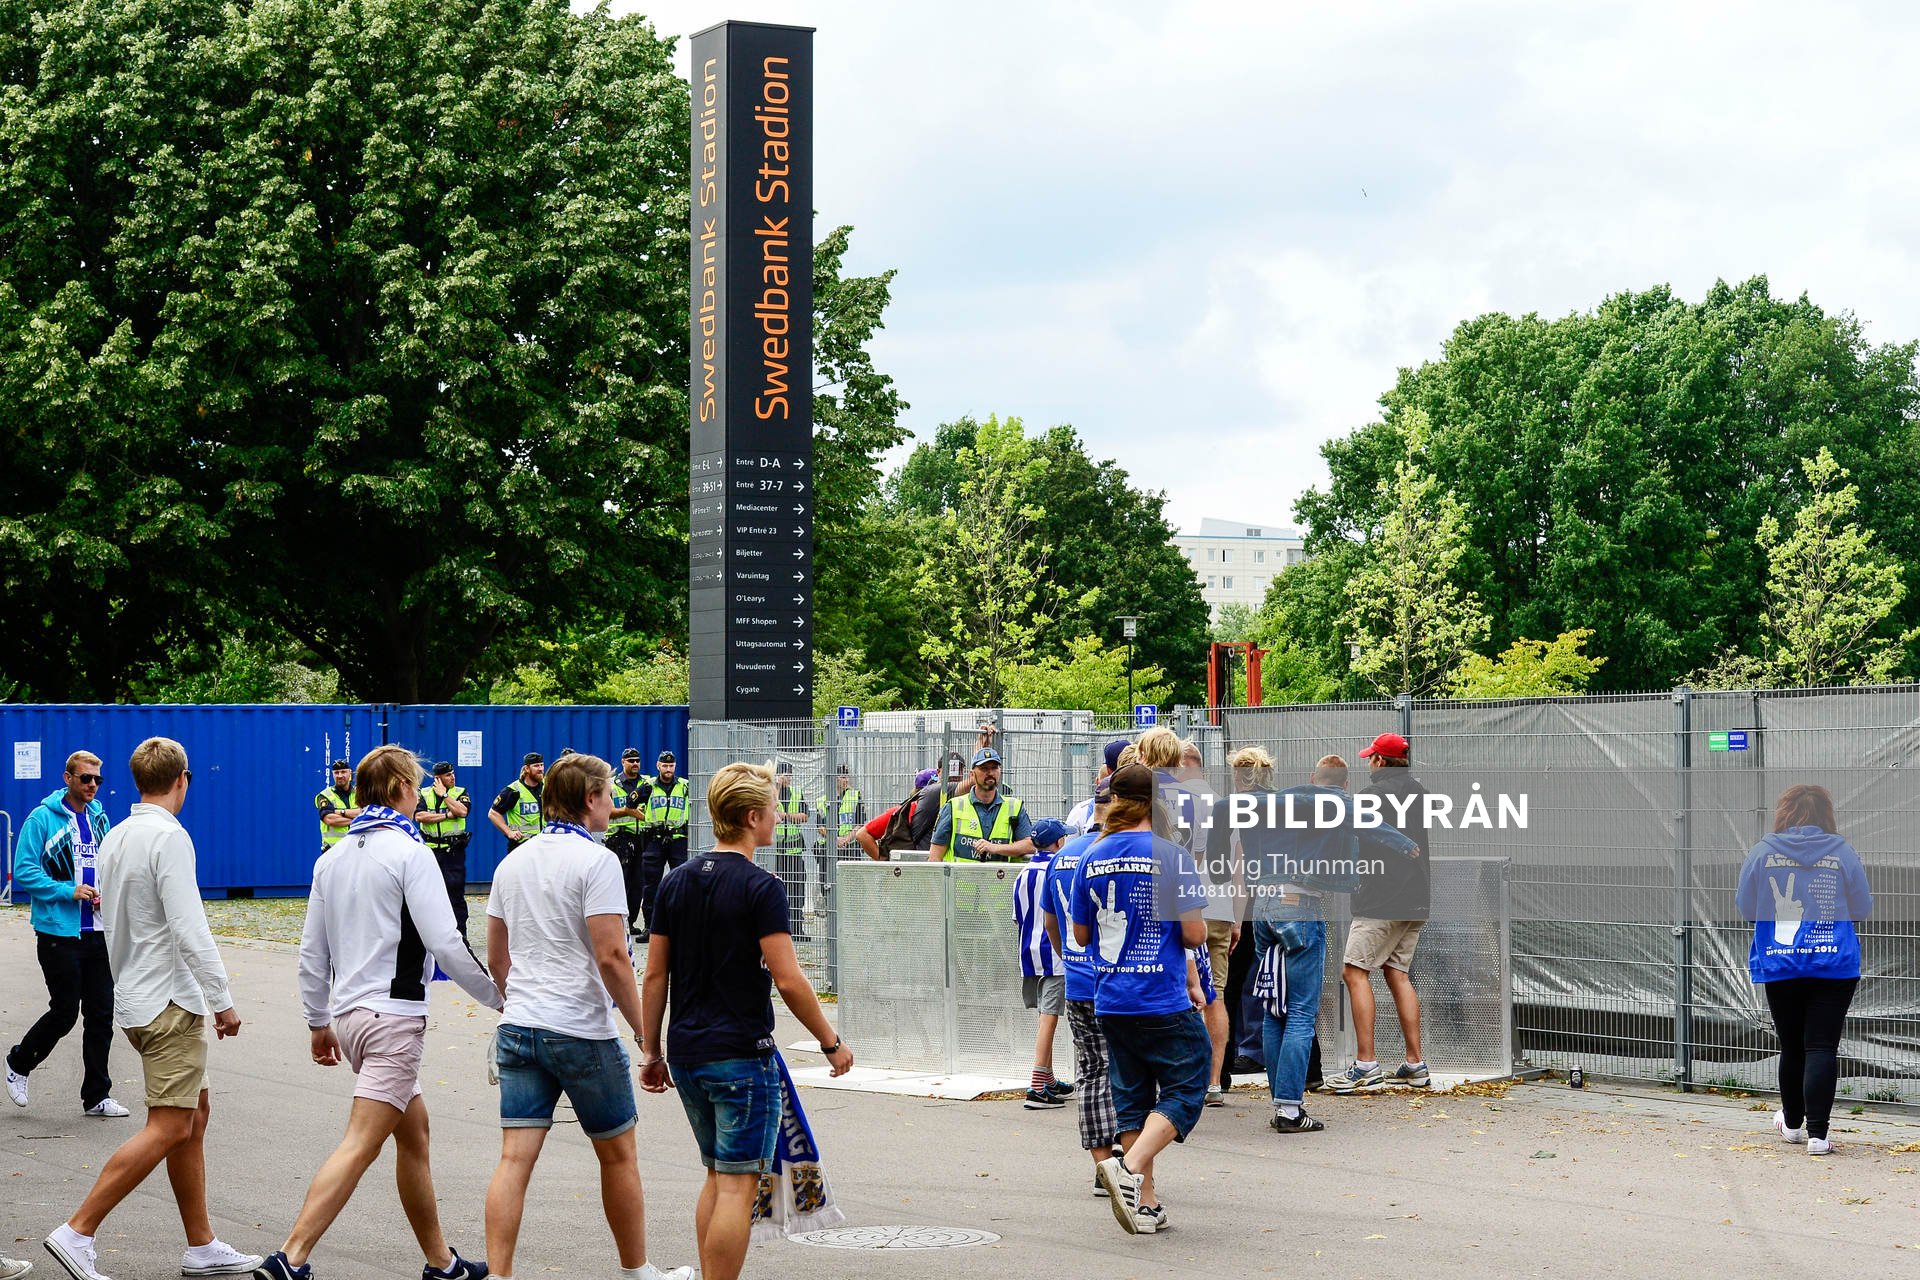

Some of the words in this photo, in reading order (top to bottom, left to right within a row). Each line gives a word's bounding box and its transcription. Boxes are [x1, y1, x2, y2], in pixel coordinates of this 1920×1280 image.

[700, 58, 717, 208] Stadion
[754, 56, 789, 203] Stadion
[699, 216, 716, 423] Swedbank
[754, 215, 789, 420] Swedbank
[736, 458, 754, 466] Entré
[760, 457, 781, 468] D-A
[760, 480, 783, 491] 37-7
[768, 527, 777, 535] 23
[736, 549, 762, 557] Biljetter
[736, 572, 770, 581] Varuintag
[736, 595, 765, 603] O'Learys
[751, 617, 777, 626] Shopen
[736, 640, 787, 648] Uttagsautomat
[736, 663, 776, 671] Huvudentré
[736, 686, 760, 694] Cygate
[652, 796, 685, 809] POLIS
[72, 841, 98, 854] riorit
[1086, 862, 1162, 879] ÄNGLARNA
[1814, 945, 1838, 953] 2014
[1136, 963, 1164, 973] 2014
